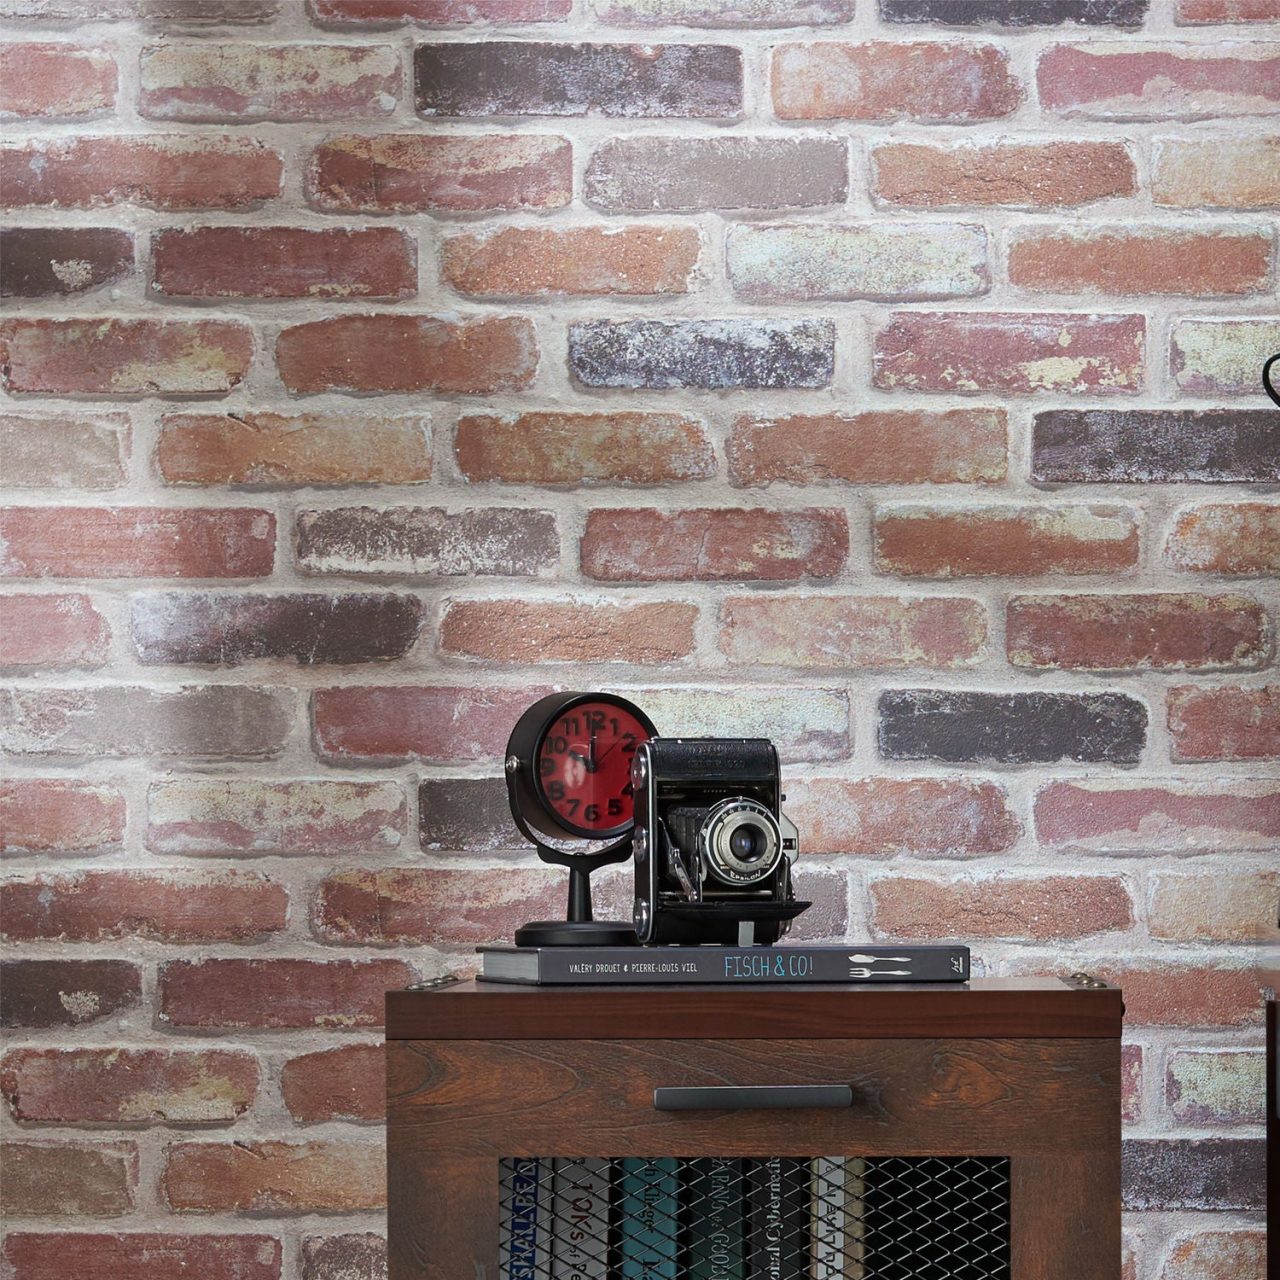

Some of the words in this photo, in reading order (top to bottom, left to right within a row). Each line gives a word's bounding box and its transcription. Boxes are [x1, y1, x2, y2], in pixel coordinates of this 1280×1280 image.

[560, 718, 581, 736] 11
[582, 711, 607, 728] 12
[610, 718, 619, 736] 1
[545, 736, 567, 754] 10
[621, 733, 637, 753] 2
[541, 757, 556, 777] 9
[548, 780, 566, 800] 8
[567, 798, 581, 817] 7
[584, 804, 600, 822] 6
[607, 798, 624, 816] 5
[595, 963, 621, 973] DROUET
[631, 963, 679, 973] PIERRE-LOUIS
[682, 963, 698, 973] VIEL
[724, 956, 769, 977] FISCH
[774, 956, 786, 977] &
[789, 956, 814, 977] CO!
